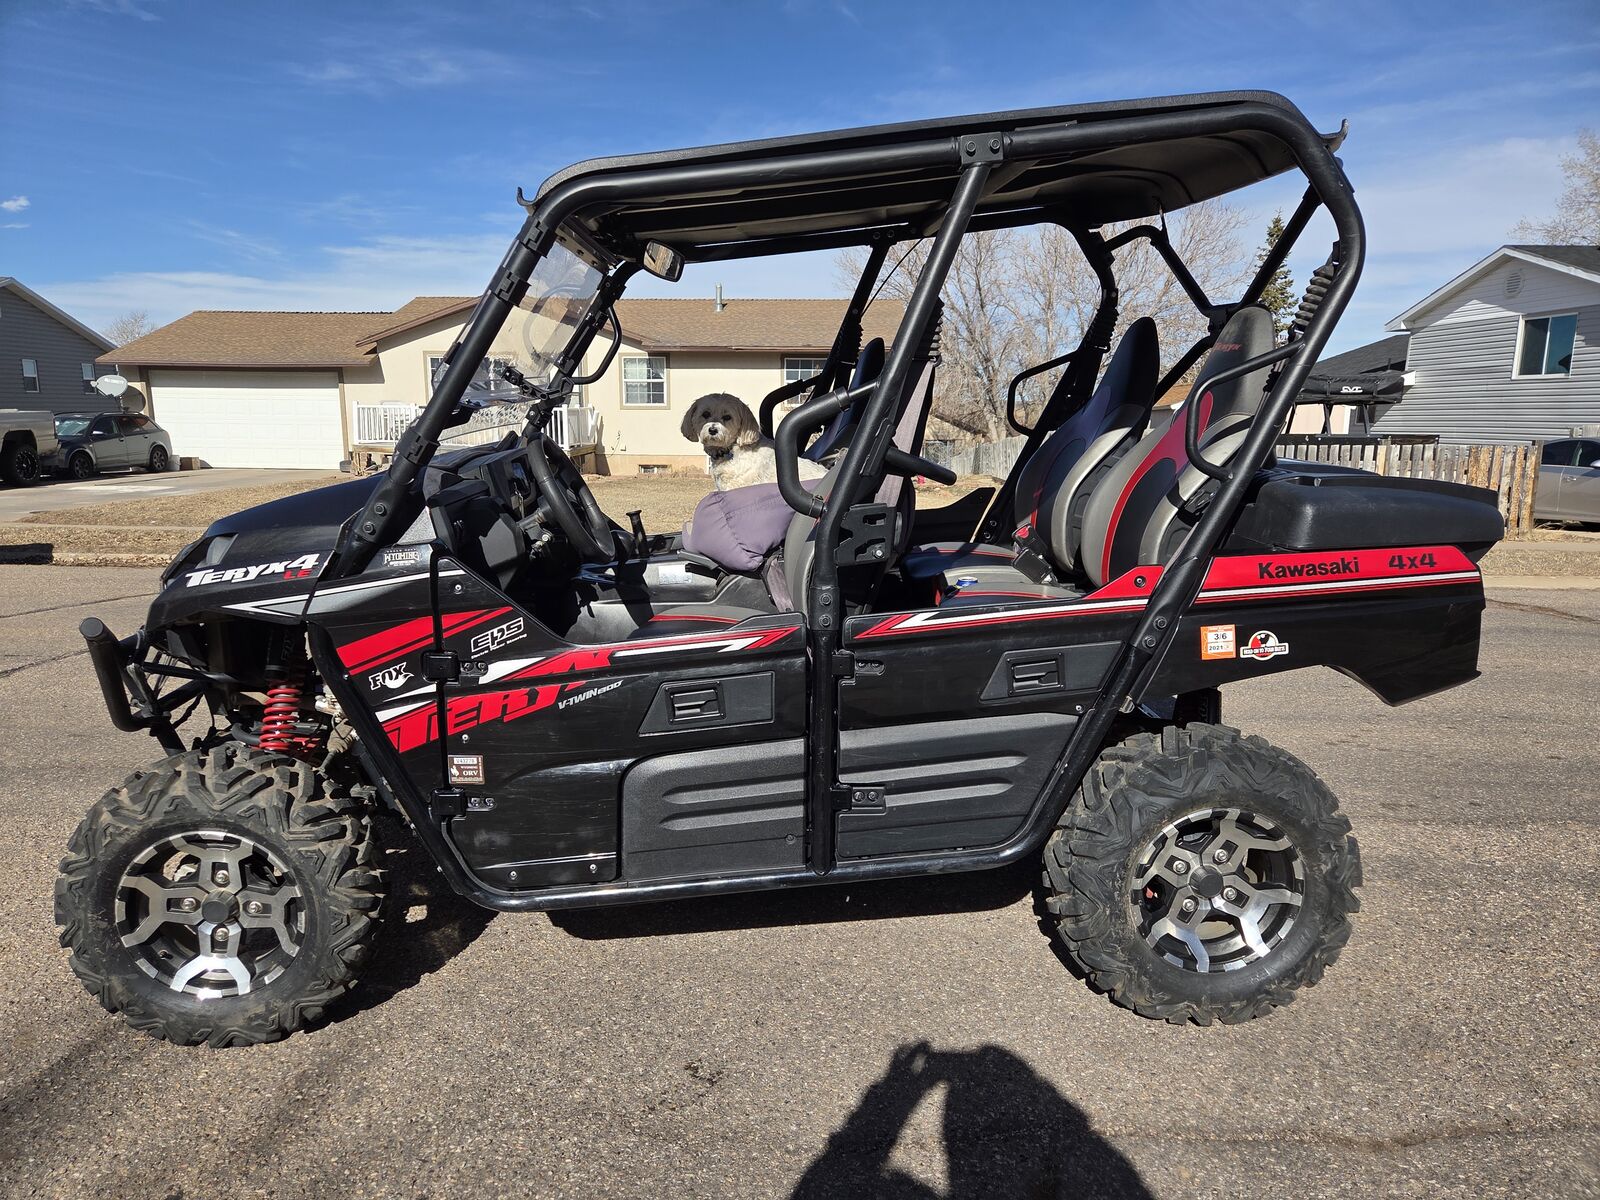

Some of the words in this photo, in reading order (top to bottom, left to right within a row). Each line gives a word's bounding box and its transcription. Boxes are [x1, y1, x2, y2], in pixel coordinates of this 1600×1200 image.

[384, 551, 419, 565] WYOMING
[1258, 557, 1359, 579] Kawasaki
[1388, 553, 1436, 570] 4x4
[283, 569, 314, 580] LE
[471, 617, 523, 652] EPS
[368, 661, 411, 690] FOX
